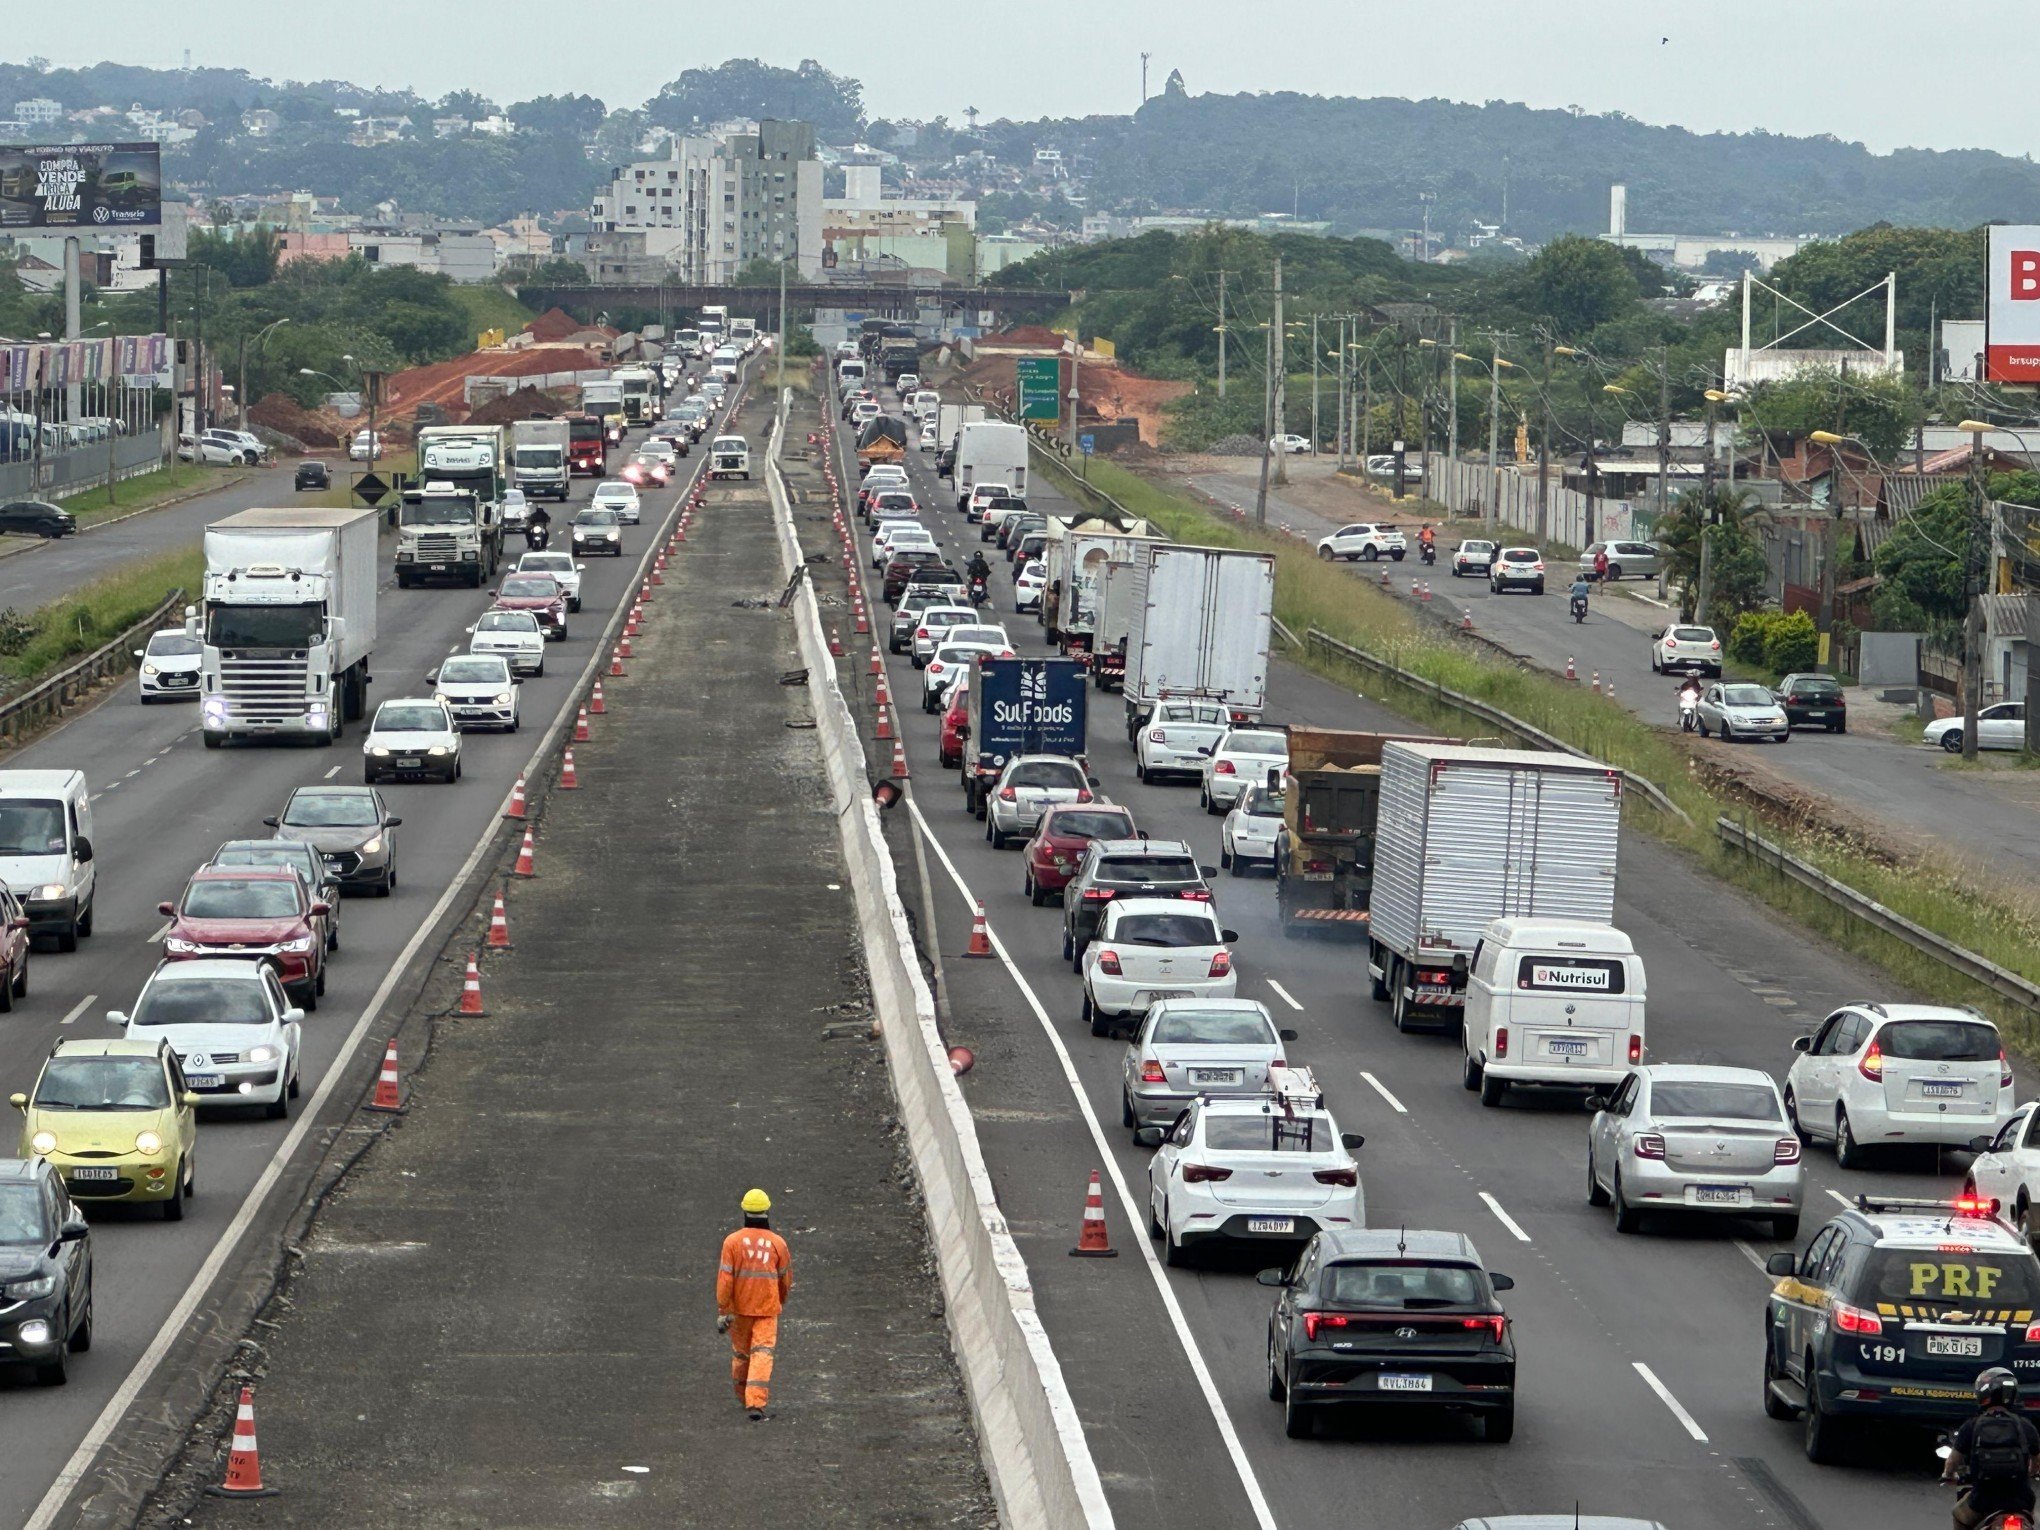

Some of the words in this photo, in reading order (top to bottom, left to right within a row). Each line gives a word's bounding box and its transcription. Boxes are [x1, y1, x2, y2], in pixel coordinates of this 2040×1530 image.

[40, 160, 80, 171] COMPRA
[37, 170, 86, 183] VENDE
[44, 194, 81, 211] ALUGA
[993, 700, 1073, 723] SulFoods
[1548, 971, 1606, 985] Nutrisul
[1909, 1262, 2002, 1299] PRF
[1873, 1345, 1906, 1364] 191
